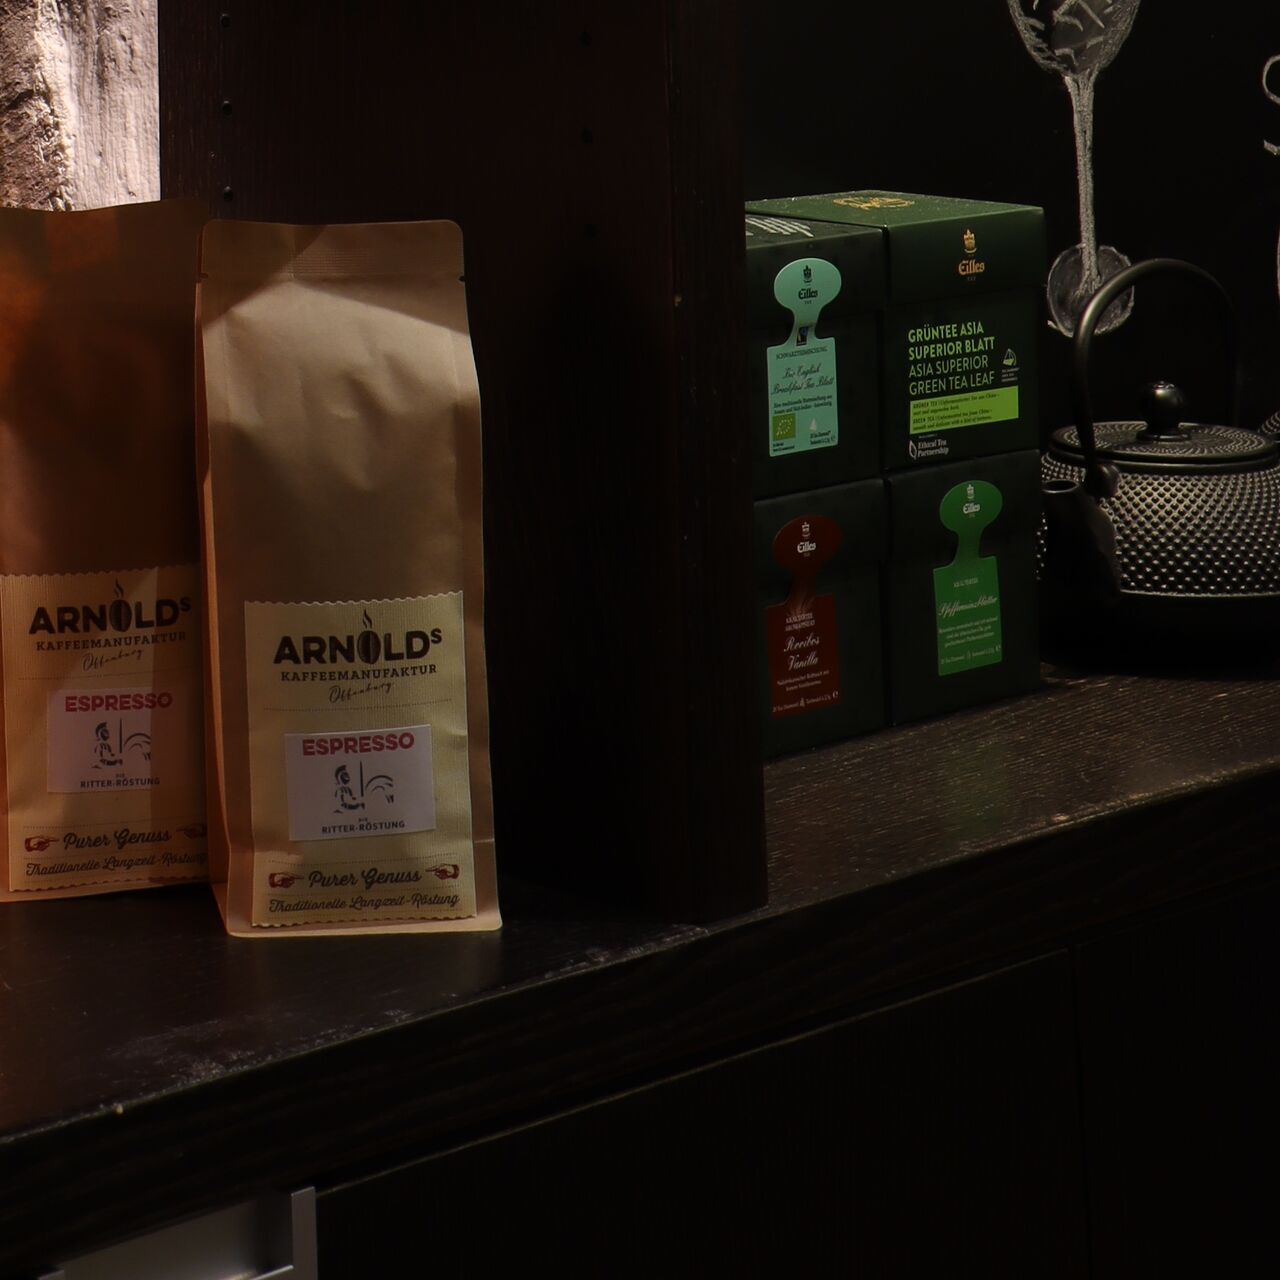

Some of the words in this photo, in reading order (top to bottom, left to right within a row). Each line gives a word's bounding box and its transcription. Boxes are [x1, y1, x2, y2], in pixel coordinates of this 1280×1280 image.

[907, 323, 959, 343] GRÜNTEE
[959, 321, 985, 337] ASIA
[908, 340, 963, 361] SUPERIOR
[964, 336, 996, 354] BLATT
[908, 362, 935, 379] ASIA
[935, 354, 989, 375] SUPERIOR
[909, 378, 947, 396] GREEN
[948, 375, 969, 391] TEA
[970, 371, 996, 388] LEAF
[36, 631, 187, 652] KAFFEEMANUFAKTUR
[82, 648, 144, 672] Offenburg
[281, 663, 438, 682] KAFFEEMANUFAKTUR
[65, 692, 174, 713] ESPRESSO
[328, 681, 393, 704] Offenburg
[302, 732, 416, 757] ESPRESSO
[63, 832, 111, 851] Purer
[113, 827, 173, 850] Genuss
[25, 861, 101, 877] Traditionelle
[308, 870, 359, 889] Purer
[361, 867, 423, 891] Genuss
[269, 898, 347, 913] Traditionelle
